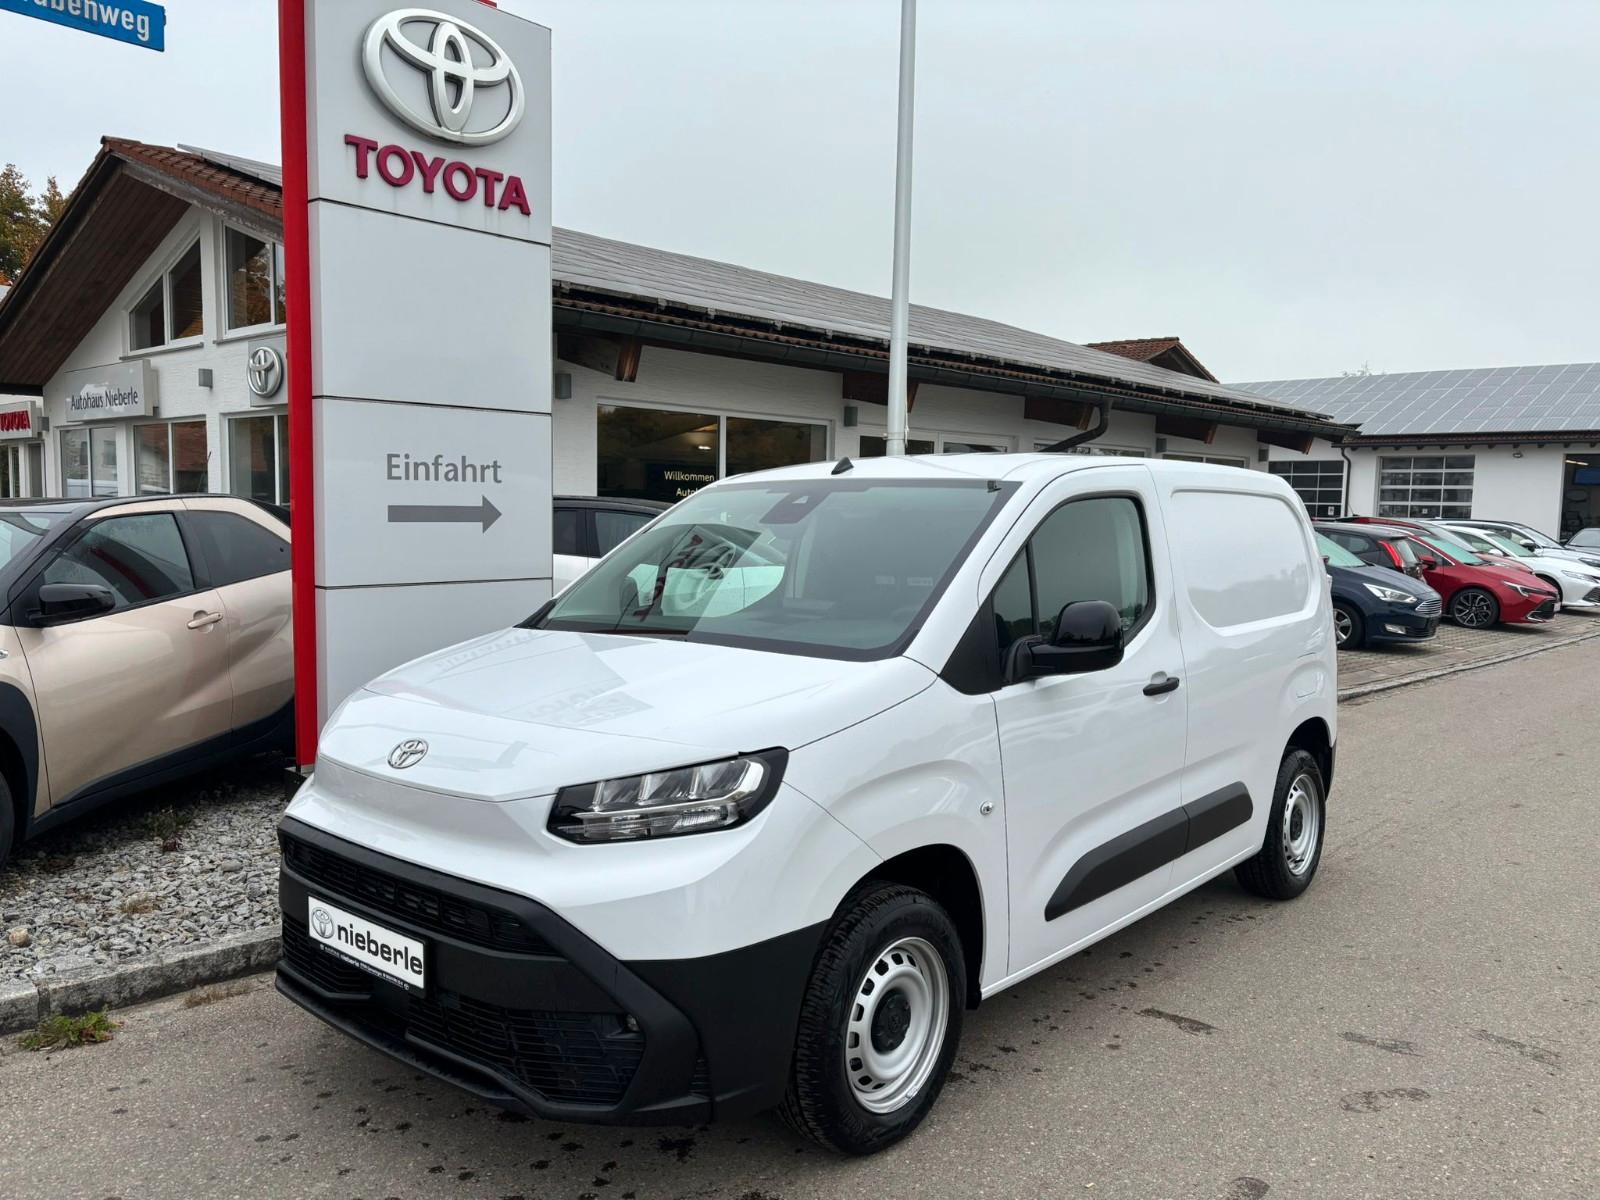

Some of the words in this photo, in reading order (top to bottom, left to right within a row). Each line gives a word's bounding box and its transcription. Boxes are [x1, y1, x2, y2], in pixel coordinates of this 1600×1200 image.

[344, 134, 531, 216] TOYOTA
[71, 392, 104, 411] Autohaus
[105, 385, 139, 407] Nieberle
[386, 453, 503, 484] Einfahrt
[664, 471, 715, 482] Willkommen
[337, 923, 423, 976] nieberle
